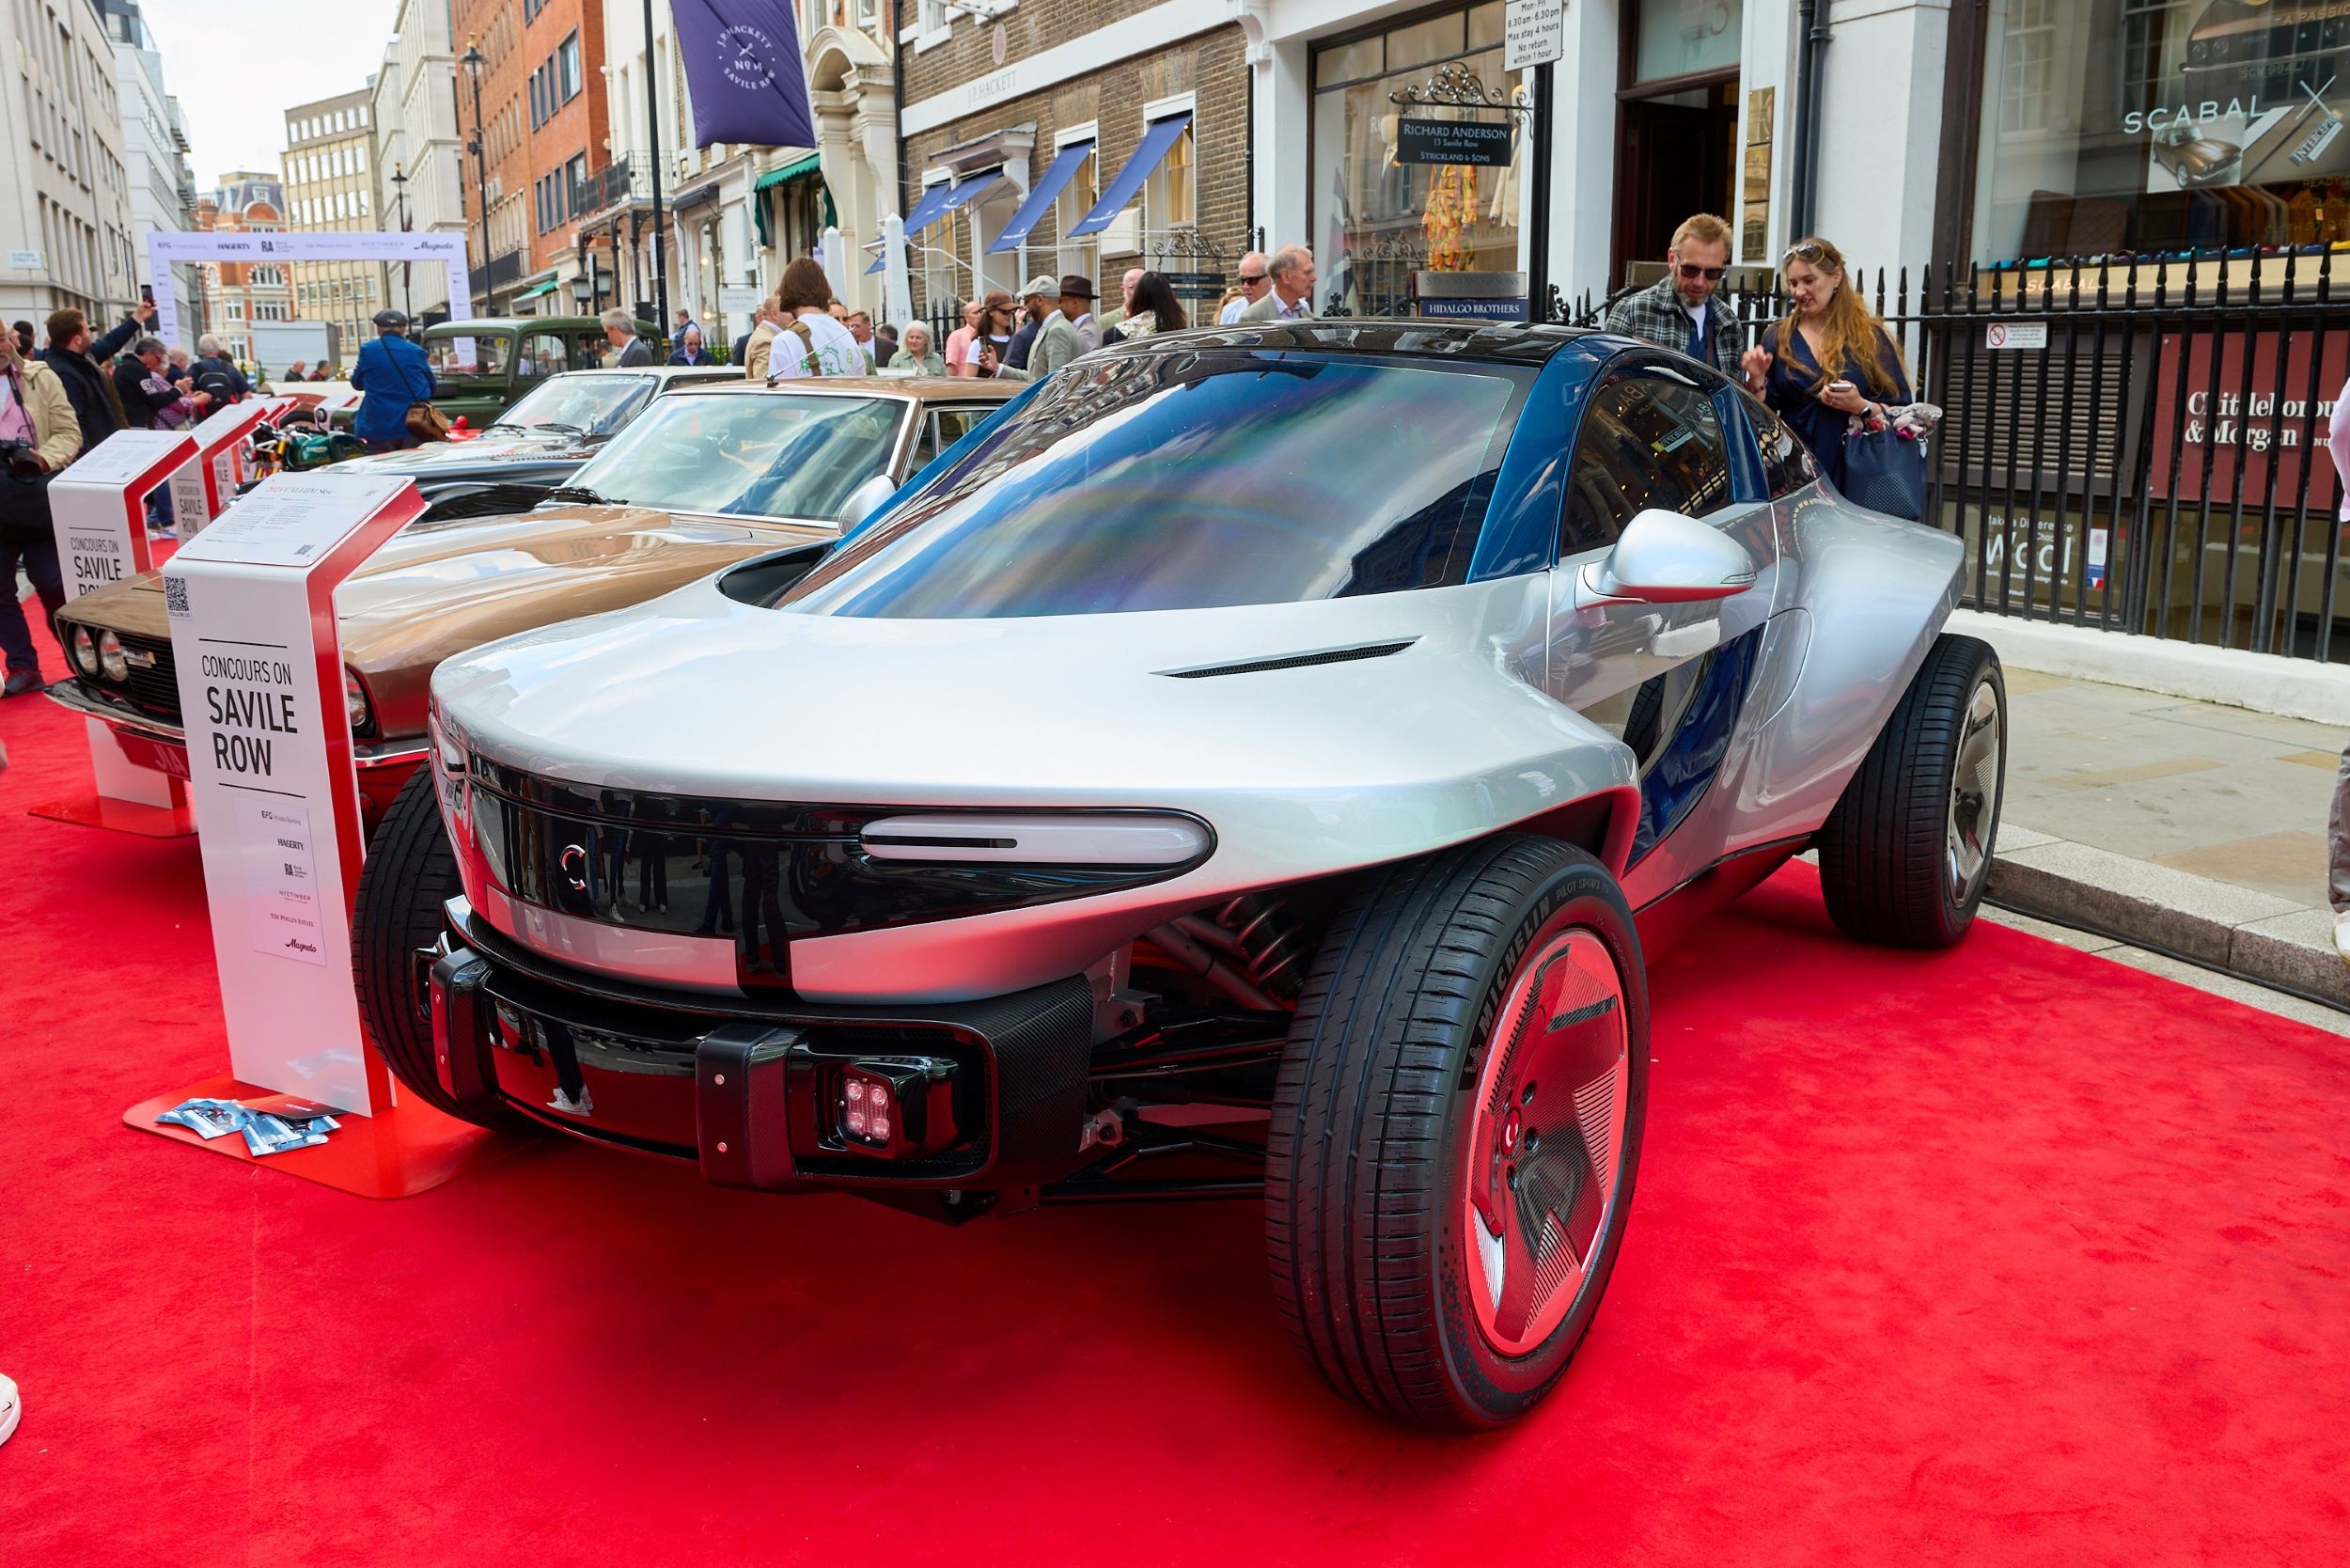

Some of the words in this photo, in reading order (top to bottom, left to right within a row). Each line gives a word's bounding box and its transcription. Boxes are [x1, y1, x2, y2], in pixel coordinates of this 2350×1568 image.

[1521, 4, 1534, 12] Mon
[1507, 33, 1519, 42] Max
[1521, 29, 1534, 39] stay
[1535, 25, 1540, 34] 4
[1542, 23, 1559, 33] hours
[1518, 44, 1527, 53] No
[1528, 39, 1547, 50] return
[1538, 49, 1552, 58] hour
[723, 68, 758, 89] SAVILE
[979, 71, 1016, 100] HACKETT
[2123, 94, 2266, 134] SCABAL
[1404, 124, 1449, 136] RICHARD
[1451, 126, 1507, 139] ANDERSON
[1443, 138, 1463, 148] Savile
[1464, 139, 1479, 148] Row
[1420, 151, 1464, 162] STRICKLAND
[1471, 153, 1490, 163] SONS
[260, 241, 274, 253] RA
[1429, 305, 1472, 314] HIDALGO
[1474, 305, 1520, 314] BROTHERS
[2185, 419, 2204, 444] &
[179, 498, 203, 515] SAVILE
[181, 518, 198, 534] ROW
[70, 537, 107, 553] CONCOURS
[109, 541, 119, 554] ON
[73, 556, 122, 581] SAVILE
[201, 655, 271, 683] CONCOURS
[273, 662, 292, 685] ON
[207, 686, 298, 733] SAVILE
[212, 731, 272, 776] ROW
[278, 839, 305, 851] HAGERTY
[1556, 883, 1576, 902] PILOT
[1579, 878, 1598, 891] SPORT
[286, 938, 317, 953] Magneto
[1478, 895, 1551, 1038] MICHELIN
